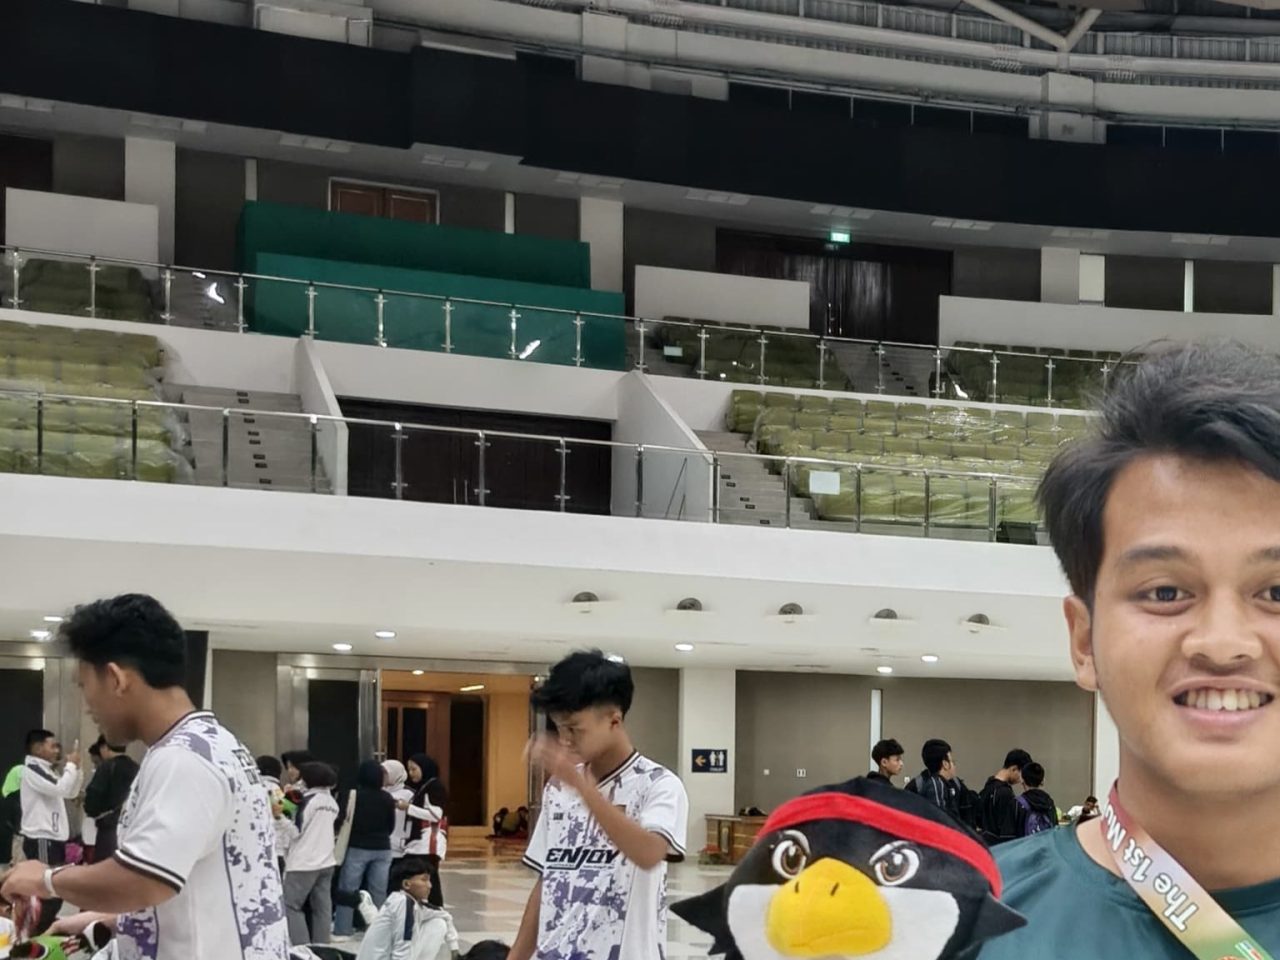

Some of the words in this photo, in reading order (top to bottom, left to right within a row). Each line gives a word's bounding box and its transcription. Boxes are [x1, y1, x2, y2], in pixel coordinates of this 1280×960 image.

[546, 846, 620, 870] ENJOY
[1122, 837, 1153, 882] 1st
[1153, 872, 1199, 932] The
